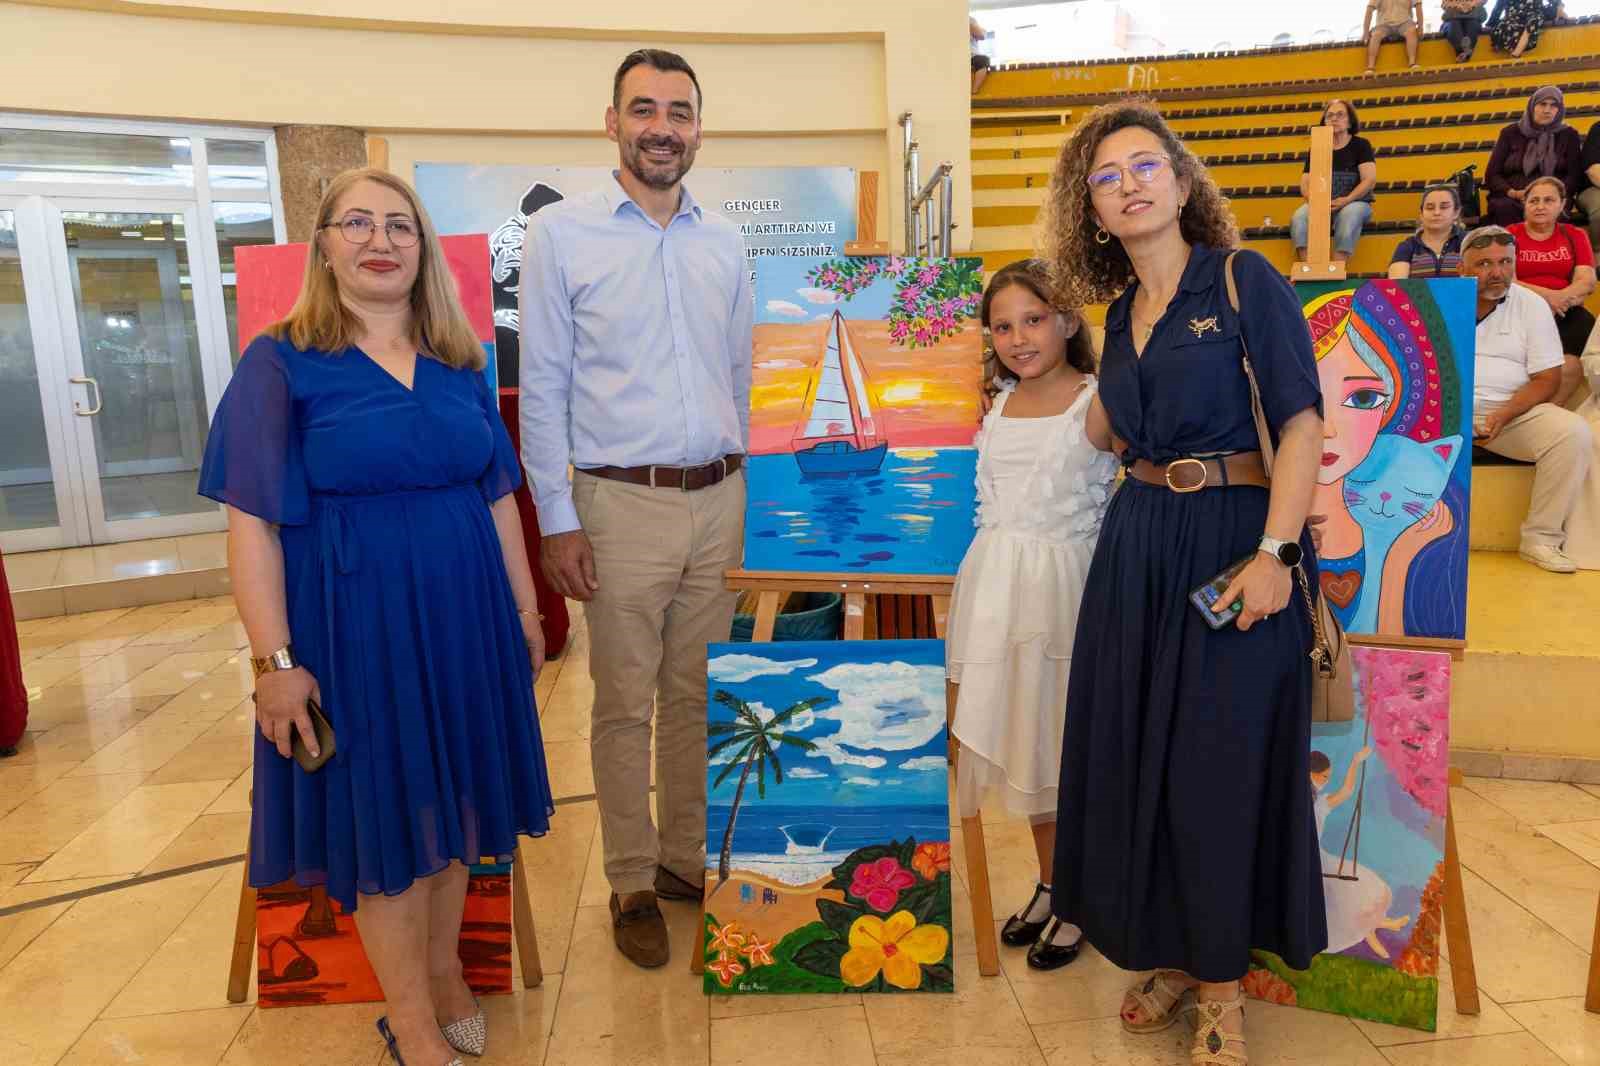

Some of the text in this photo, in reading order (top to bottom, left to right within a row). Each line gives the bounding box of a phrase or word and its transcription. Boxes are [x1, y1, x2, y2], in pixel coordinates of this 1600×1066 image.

[724, 200, 781, 213] GENÇLER
[755, 222, 815, 234] ARTTIRAN
[818, 222, 834, 232] VE
